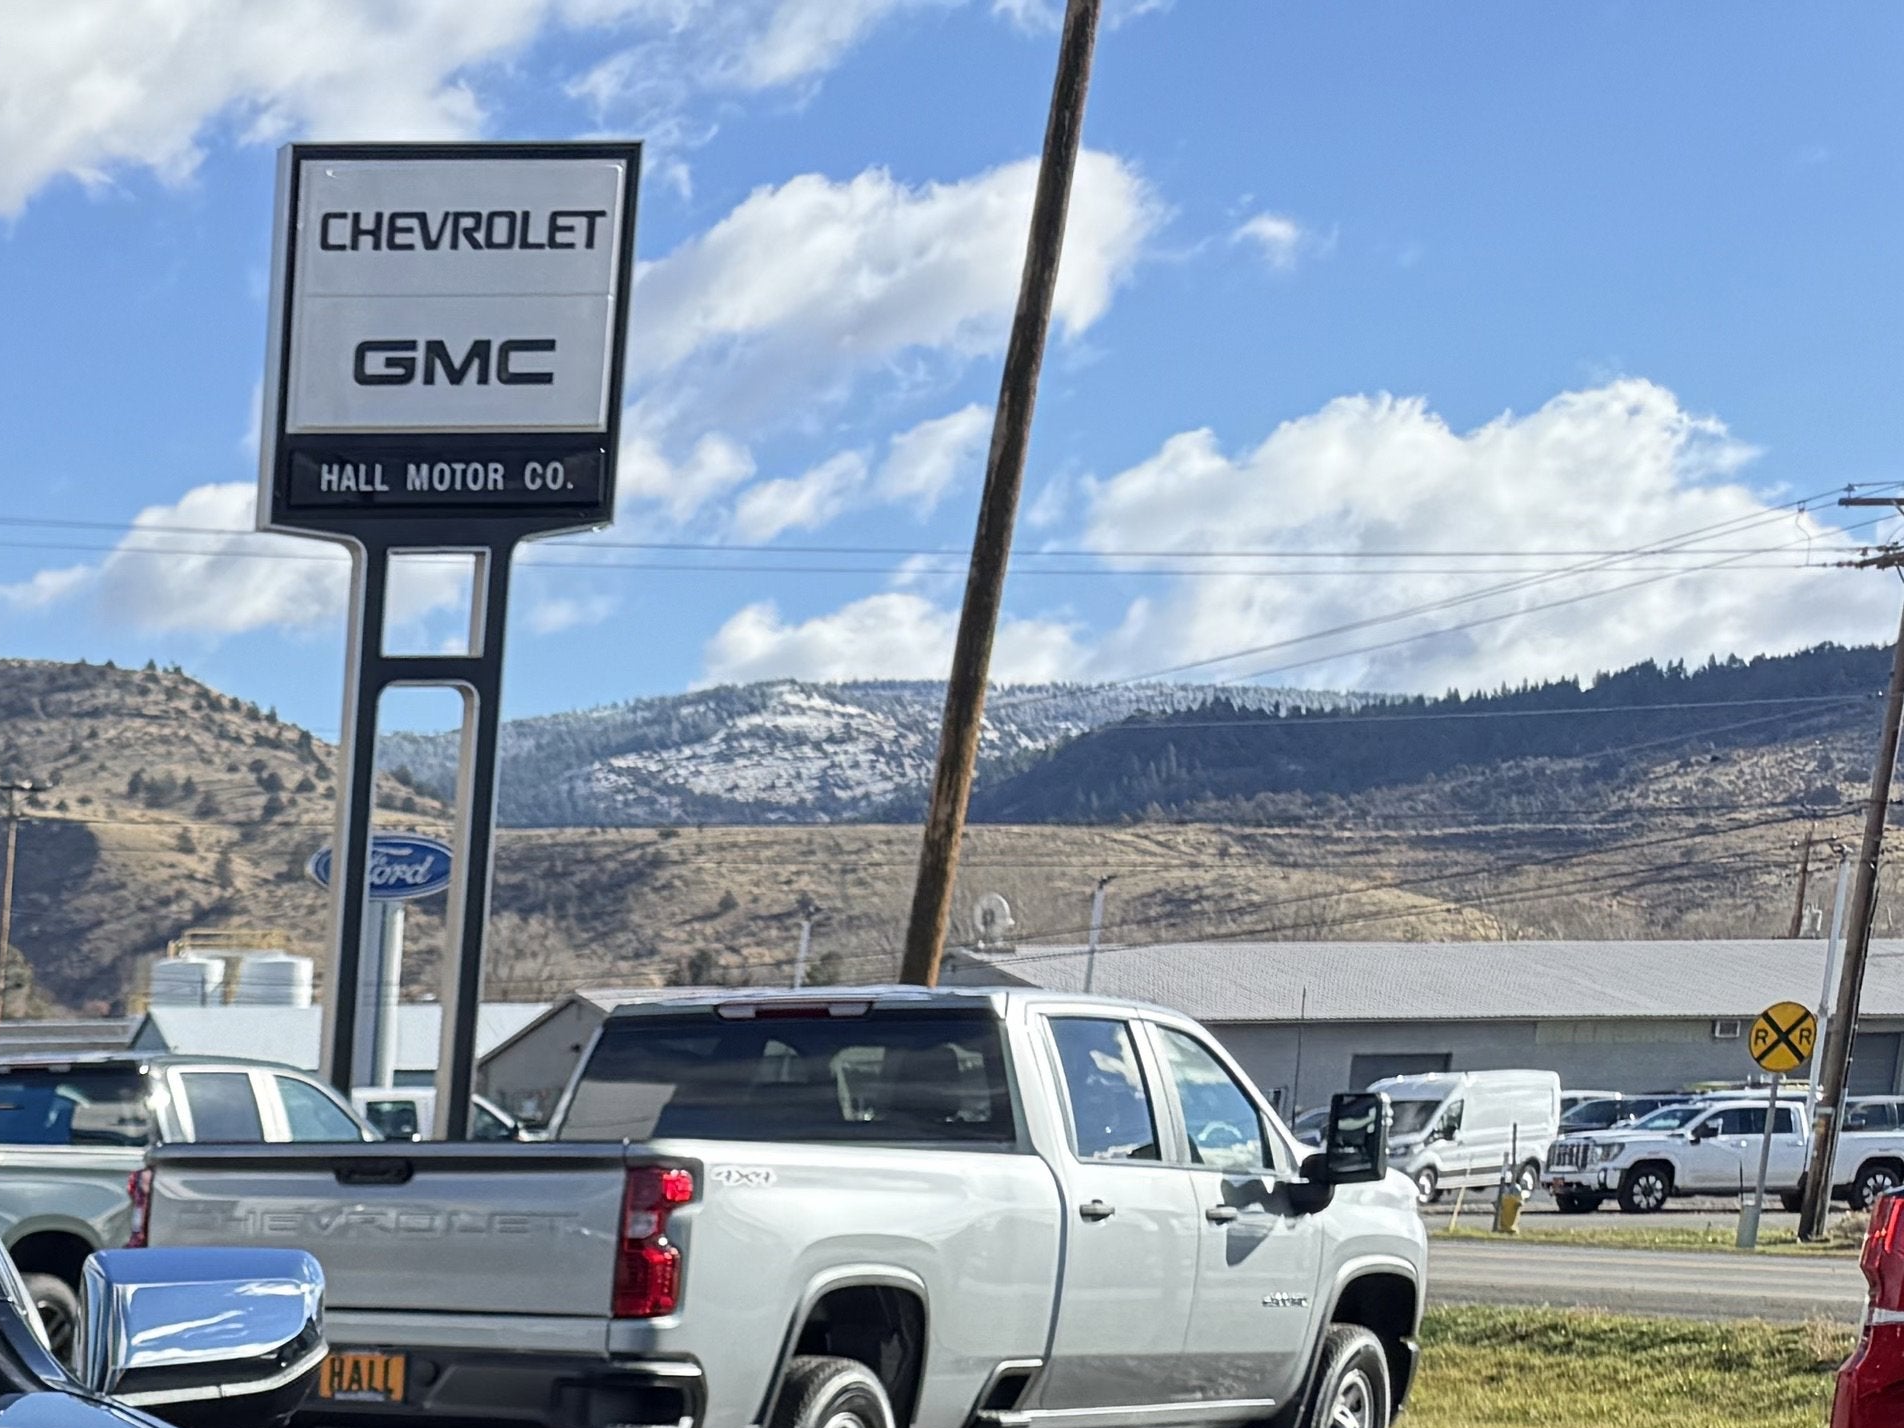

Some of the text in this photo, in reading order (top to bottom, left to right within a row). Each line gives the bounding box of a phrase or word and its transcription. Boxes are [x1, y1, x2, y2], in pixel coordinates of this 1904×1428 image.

[319, 210, 608, 251] CHEVROLET
[353, 339, 557, 386] GMC
[320, 461, 575, 492] HALL MOTOR CO.
[178, 1201, 580, 1238] CHEVROLET
[330, 1357, 393, 1393] HALL
